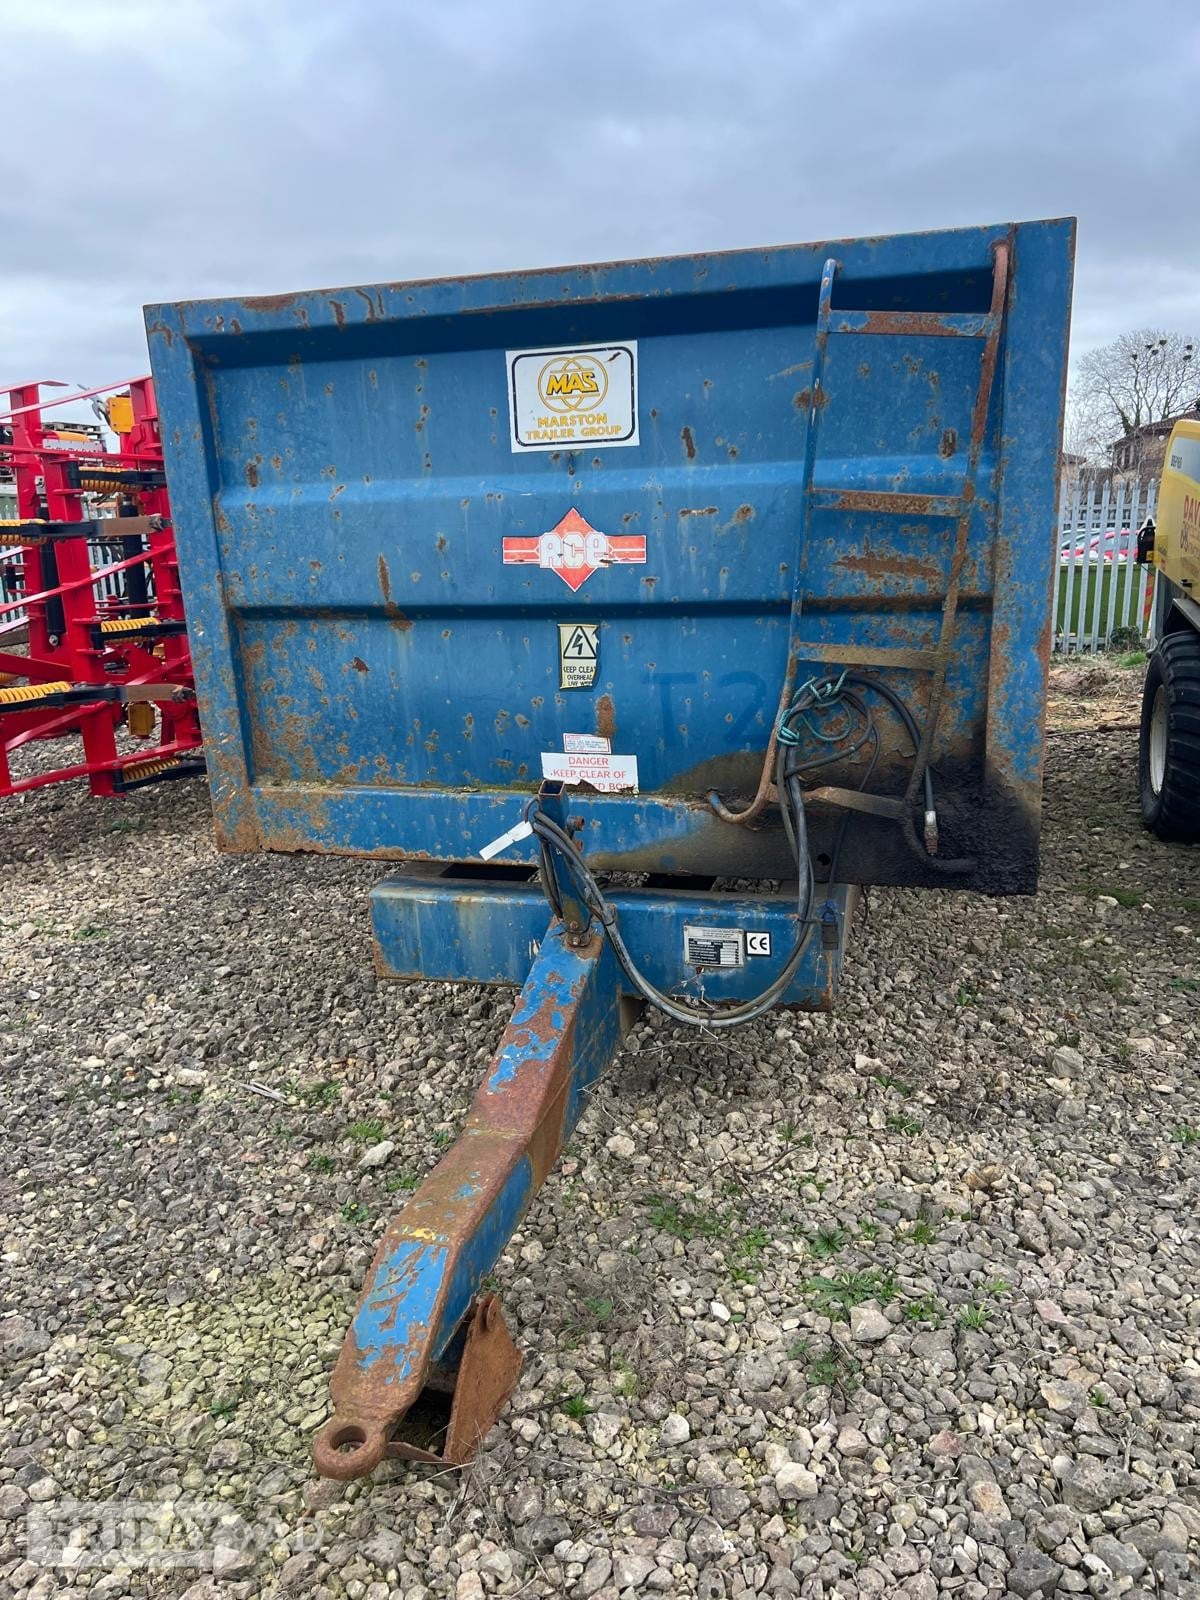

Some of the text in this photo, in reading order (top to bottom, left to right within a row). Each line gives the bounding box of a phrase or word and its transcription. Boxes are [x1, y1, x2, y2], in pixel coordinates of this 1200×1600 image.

[546, 371, 599, 395] MAS
[537, 413, 608, 428] MARSTON
[526, 425, 622, 440] TRAILER GROUP
[568, 756, 609, 765] DANGER
[553, 769, 627, 779] KEEP CLEAR OF
[749, 936, 767, 951] CE
